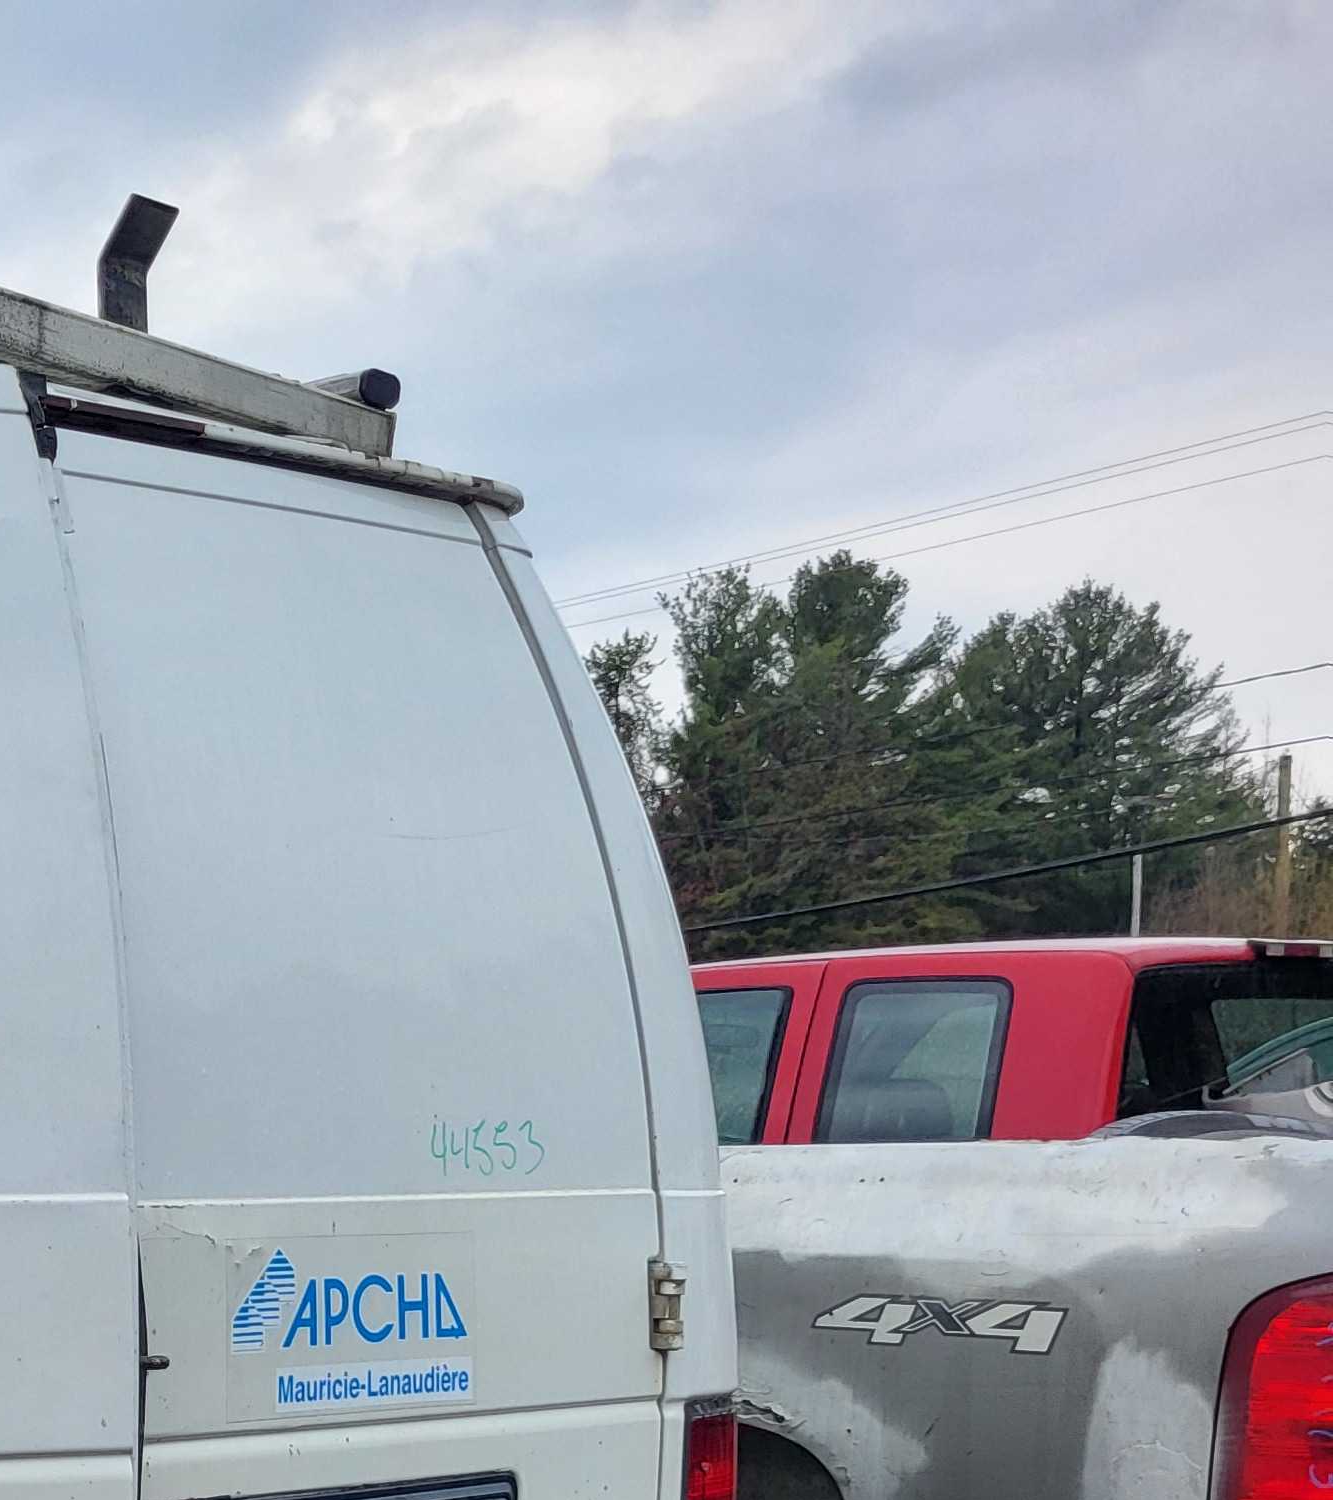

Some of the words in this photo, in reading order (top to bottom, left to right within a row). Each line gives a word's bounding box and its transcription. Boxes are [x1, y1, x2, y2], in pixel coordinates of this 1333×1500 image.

[430, 1116, 546, 1177] 44553
[281, 1272, 469, 1350] APCHA
[276, 1363, 470, 1406] Mauricie-Lanaudière
